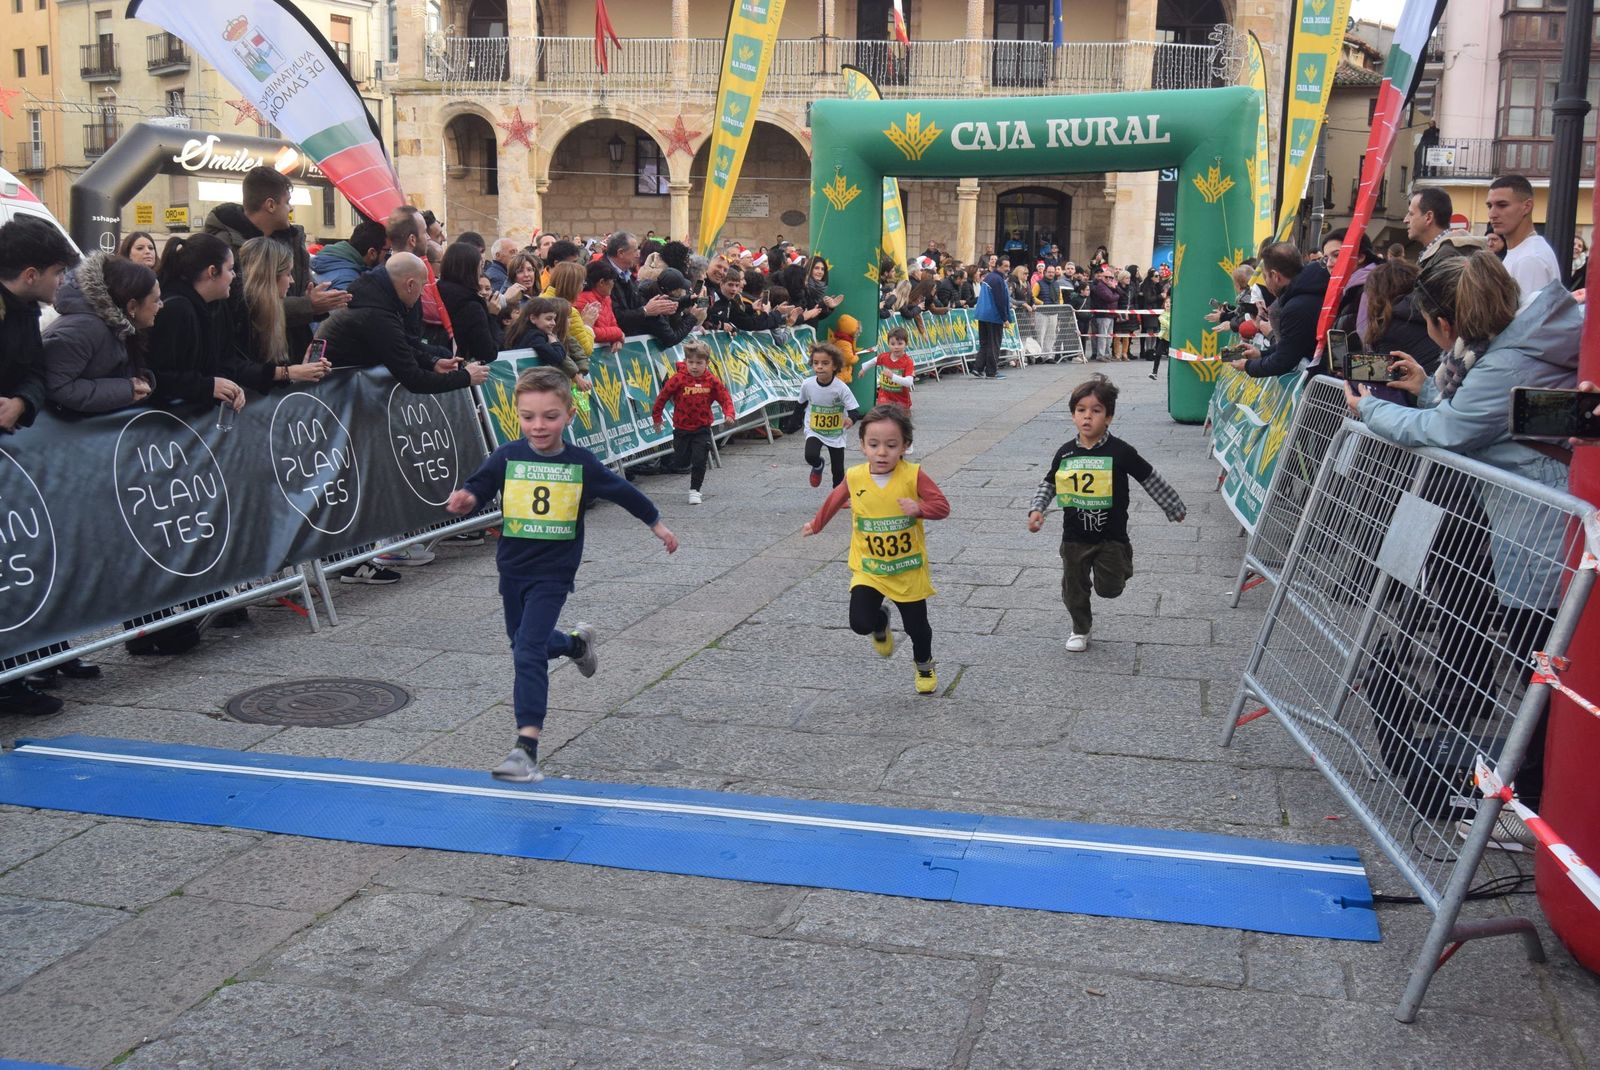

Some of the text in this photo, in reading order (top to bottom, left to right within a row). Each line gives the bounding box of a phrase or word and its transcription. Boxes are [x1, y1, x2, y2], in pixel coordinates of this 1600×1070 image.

[951, 115, 1170, 151] CAJA RURAL
[173, 135, 263, 172] Smiles
[401, 403, 431, 426] IM
[814, 414, 840, 428] 1330
[288, 418, 327, 446] IM
[397, 428, 450, 457] PLAN
[137, 440, 190, 473] IM
[281, 446, 351, 482] PLAN
[413, 457, 450, 483] TES
[527, 472, 573, 481] CAJA RURAL
[1069, 473, 1095, 494] 12
[127, 472, 217, 515] PLAN
[303, 478, 348, 509] TES
[531, 486, 550, 516] 8
[1072, 498, 1087, 506] CAJA
[153, 511, 215, 548] TES
[524, 524, 572, 534] CAJA RURAL
[865, 532, 912, 557] 1333
[880, 558, 920, 572] CAJA RURAL
